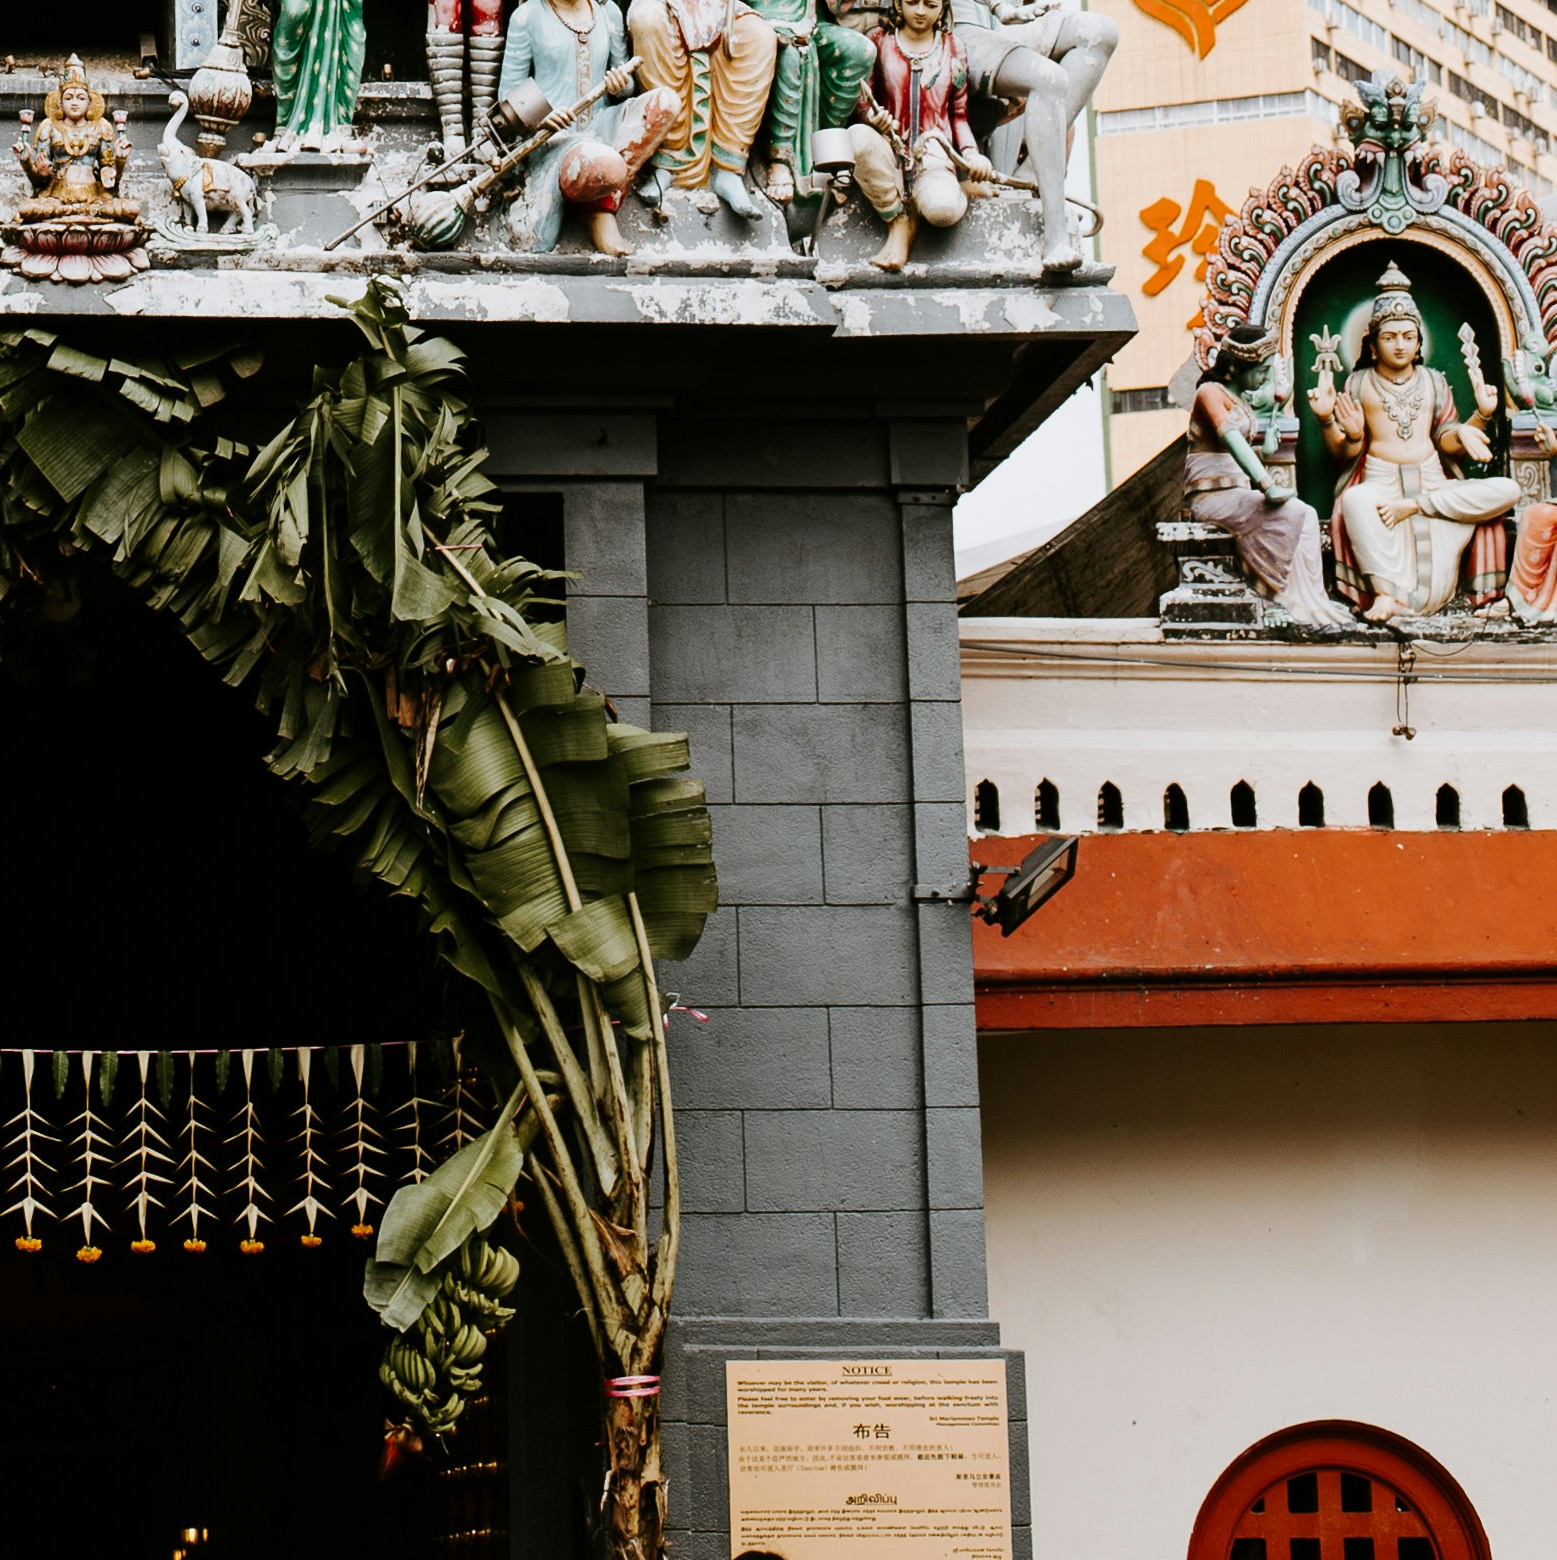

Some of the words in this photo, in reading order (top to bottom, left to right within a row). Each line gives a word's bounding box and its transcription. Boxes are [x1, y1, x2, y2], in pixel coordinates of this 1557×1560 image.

[842, 1366, 892, 1375] NOTICE
[853, 1424, 891, 1440] 布告
[846, 1493, 898, 1505] அறிவிப்பு
